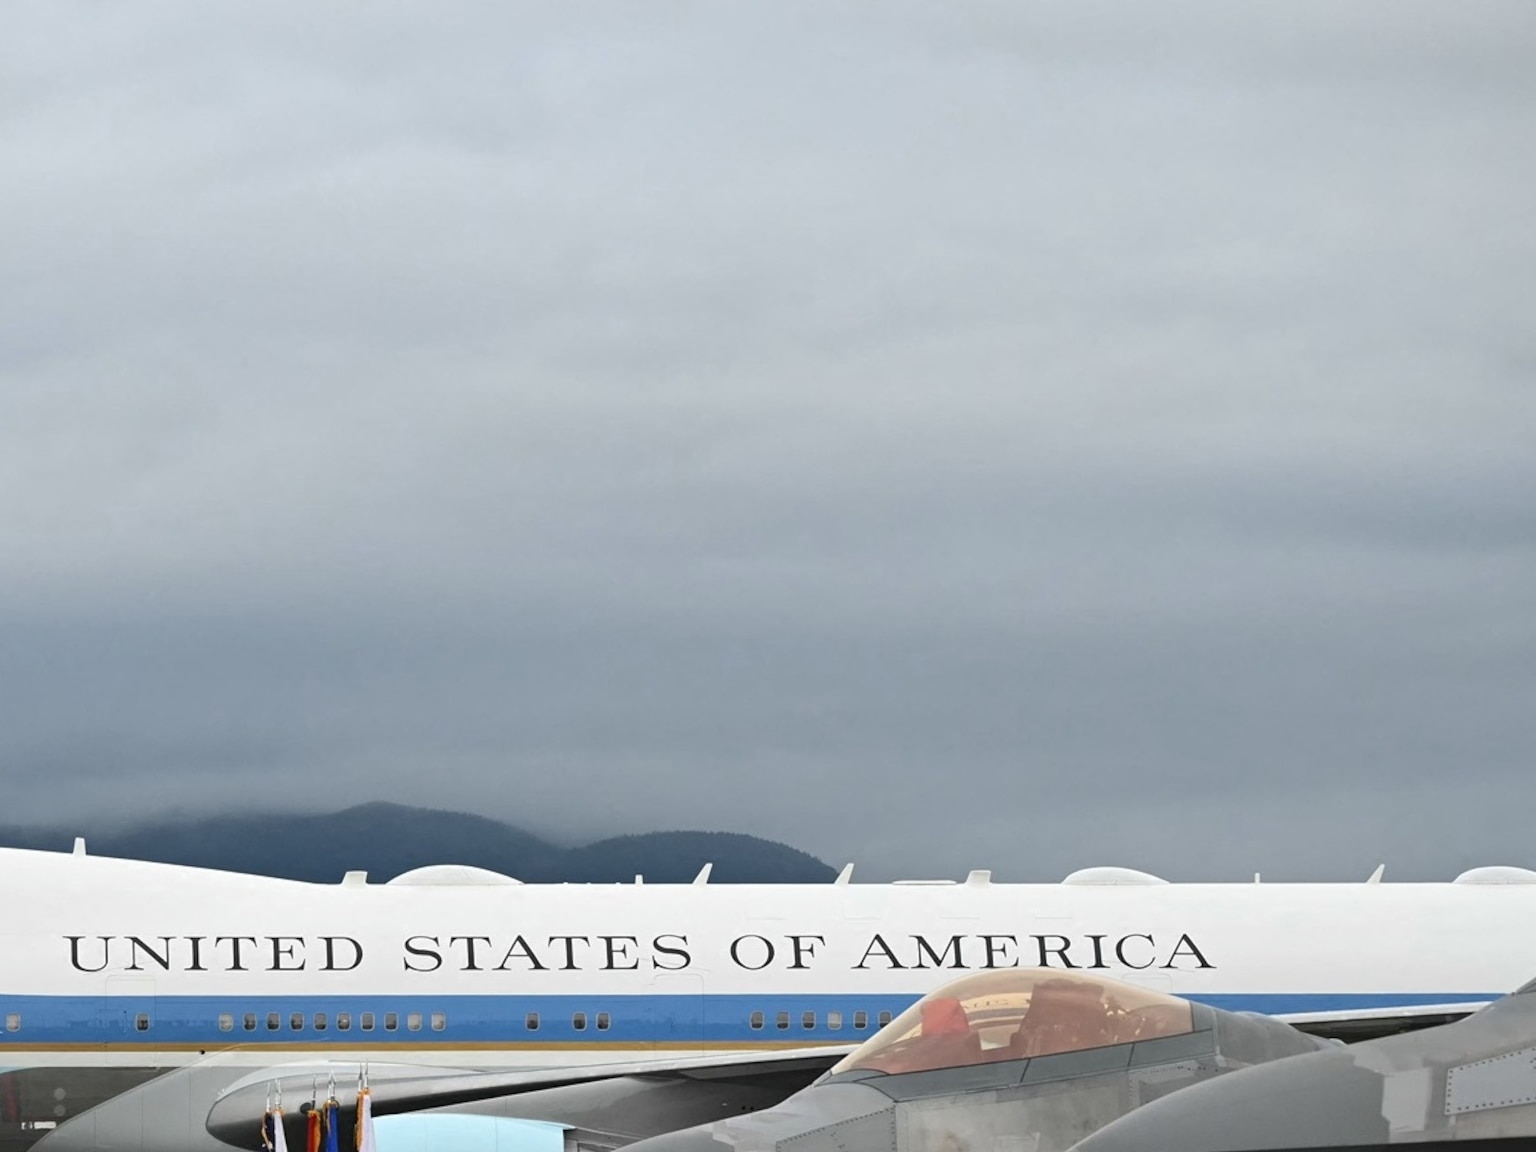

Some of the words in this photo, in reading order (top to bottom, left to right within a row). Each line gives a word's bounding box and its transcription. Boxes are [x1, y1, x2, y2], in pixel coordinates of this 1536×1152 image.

[64, 934, 364, 973] UNITED
[402, 934, 692, 972] STATES
[729, 934, 827, 971] OF
[853, 932, 1217, 970] AMERICA
